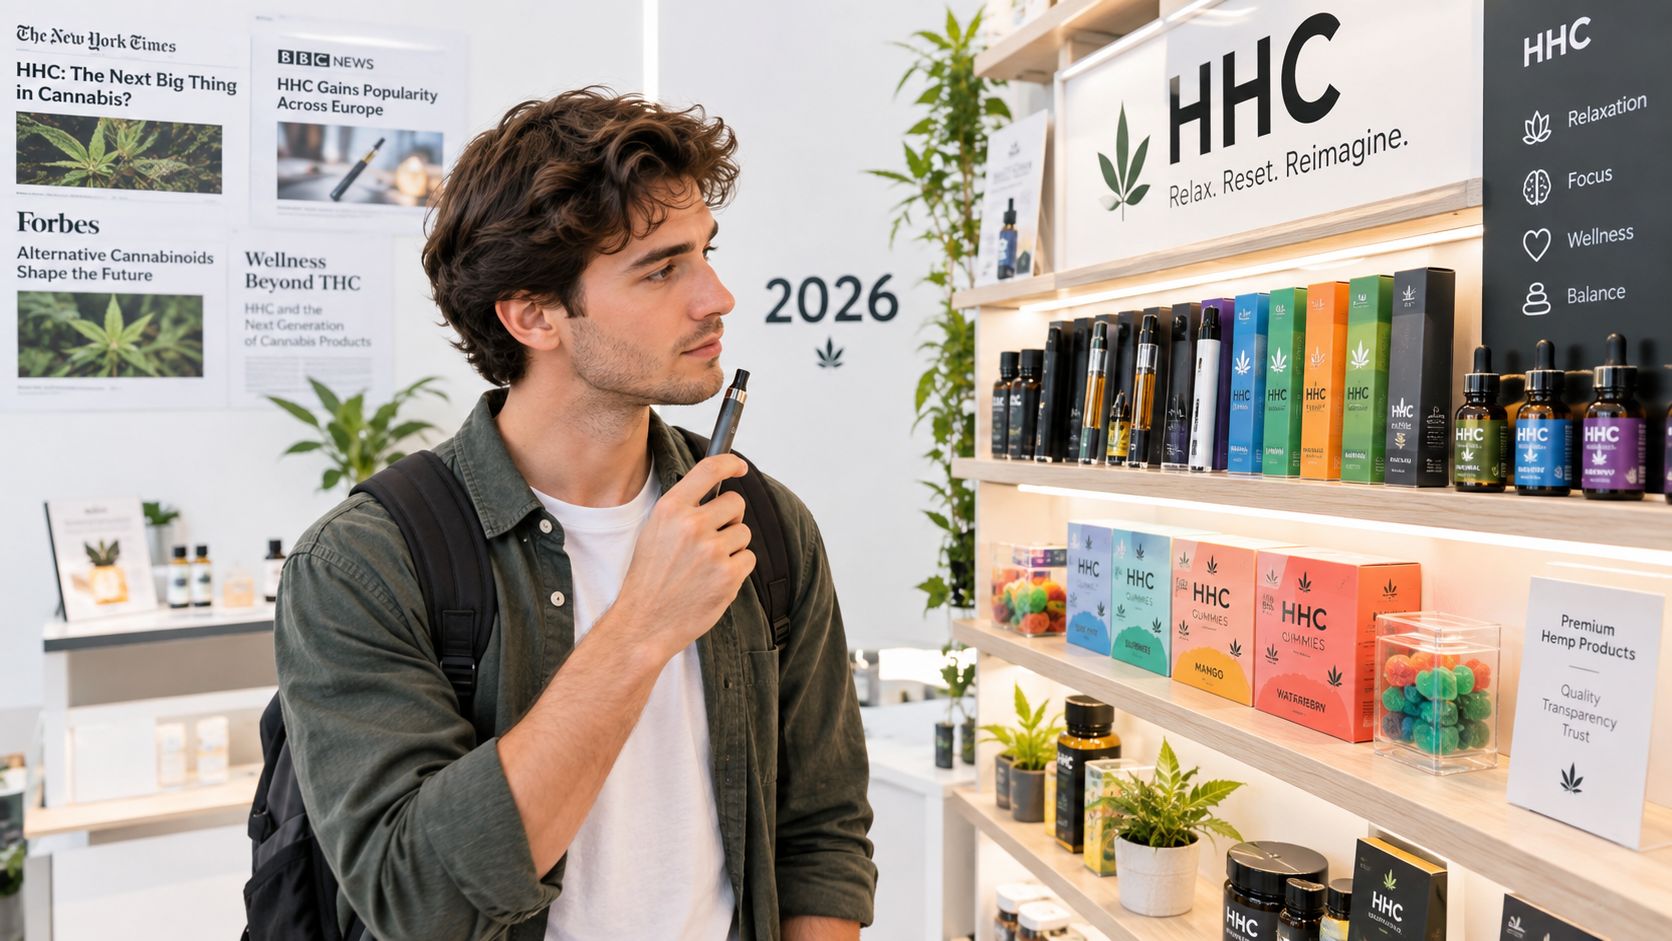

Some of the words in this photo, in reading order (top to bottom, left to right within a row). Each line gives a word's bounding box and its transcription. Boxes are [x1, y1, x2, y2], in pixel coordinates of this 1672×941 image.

[16, 24, 47, 44] The
[50, 28, 84, 47] New
[87, 31, 127, 51] York
[129, 33, 177, 53] Times
[1524, 16, 1592, 67] HHC
[278, 49, 330, 68] BBC
[333, 56, 374, 70] NEWS
[16, 62, 66, 81] HHC:
[71, 66, 104, 83] The
[109, 69, 151, 87] Next
[156, 72, 184, 92] Big
[188, 75, 237, 95] Thing
[1169, 12, 1341, 165] HHC
[16, 85, 33, 101] in
[38, 86, 132, 107] Cannabis?
[277, 77, 313, 93] HHC
[317, 80, 360, 97] Gains
[363, 83, 438, 104] Popularity
[277, 96, 327, 112] Across
[331, 100, 384, 118] Europe
[1568, 95, 1648, 127] Relaxation
[1169, 180, 1217, 208] Relax.
[1223, 161, 1278, 195] Reset.
[1286, 127, 1409, 178] Reimagine.
[1568, 168, 1613, 189] Focus
[17, 211, 100, 235] Forbes
[1567, 226, 1634, 248] Wellness
[17, 246, 107, 262] Alternative
[110, 248, 214, 265] Cannabinoids
[244, 251, 326, 269] Wellness
[17, 265, 68, 282] Shape
[72, 266, 98, 281] the
[102, 267, 153, 282] Future
[245, 274, 314, 293] Beyond
[318, 275, 361, 291] THC
[765, 274, 899, 323] 2026
[1567, 285, 1626, 303] Balance
[245, 303, 273, 315] HHC
[276, 303, 299, 316] and
[302, 303, 323, 316] the
[245, 318, 273, 331] Next
[277, 319, 344, 332] Generation
[244, 334, 258, 347] of
[260, 334, 316, 347] Cannabis
[319, 335, 372, 348] Products
[1233, 389, 1250, 401] HHC
[1268, 388, 1287, 401] HHC
[1306, 388, 1326, 400] HHC
[1347, 386, 1369, 400] HHC
[1391, 404, 1414, 418] HHC
[1456, 428, 1484, 441] HHC
[1517, 427, 1549, 442] HHC
[1584, 426, 1620, 442] HHC
[1078, 558, 1100, 578] HHC
[1126, 568, 1154, 590] HHC
[1193, 582, 1230, 609] HHC
[1192, 609, 1228, 627] GUMMIES
[1282, 600, 1327, 631] HHC
[1561, 614, 1615, 636] Premium
[1541, 630, 1576, 650] Hemp
[1579, 637, 1636, 661] Products
[1195, 662, 1224, 680] MANGO
[1561, 684, 1601, 707] Quality
[1542, 698, 1618, 732] Transparency
[1561, 723, 1591, 744] Trust
[1372, 890, 1403, 922] HHC
[1226, 906, 1258, 938] HHC
